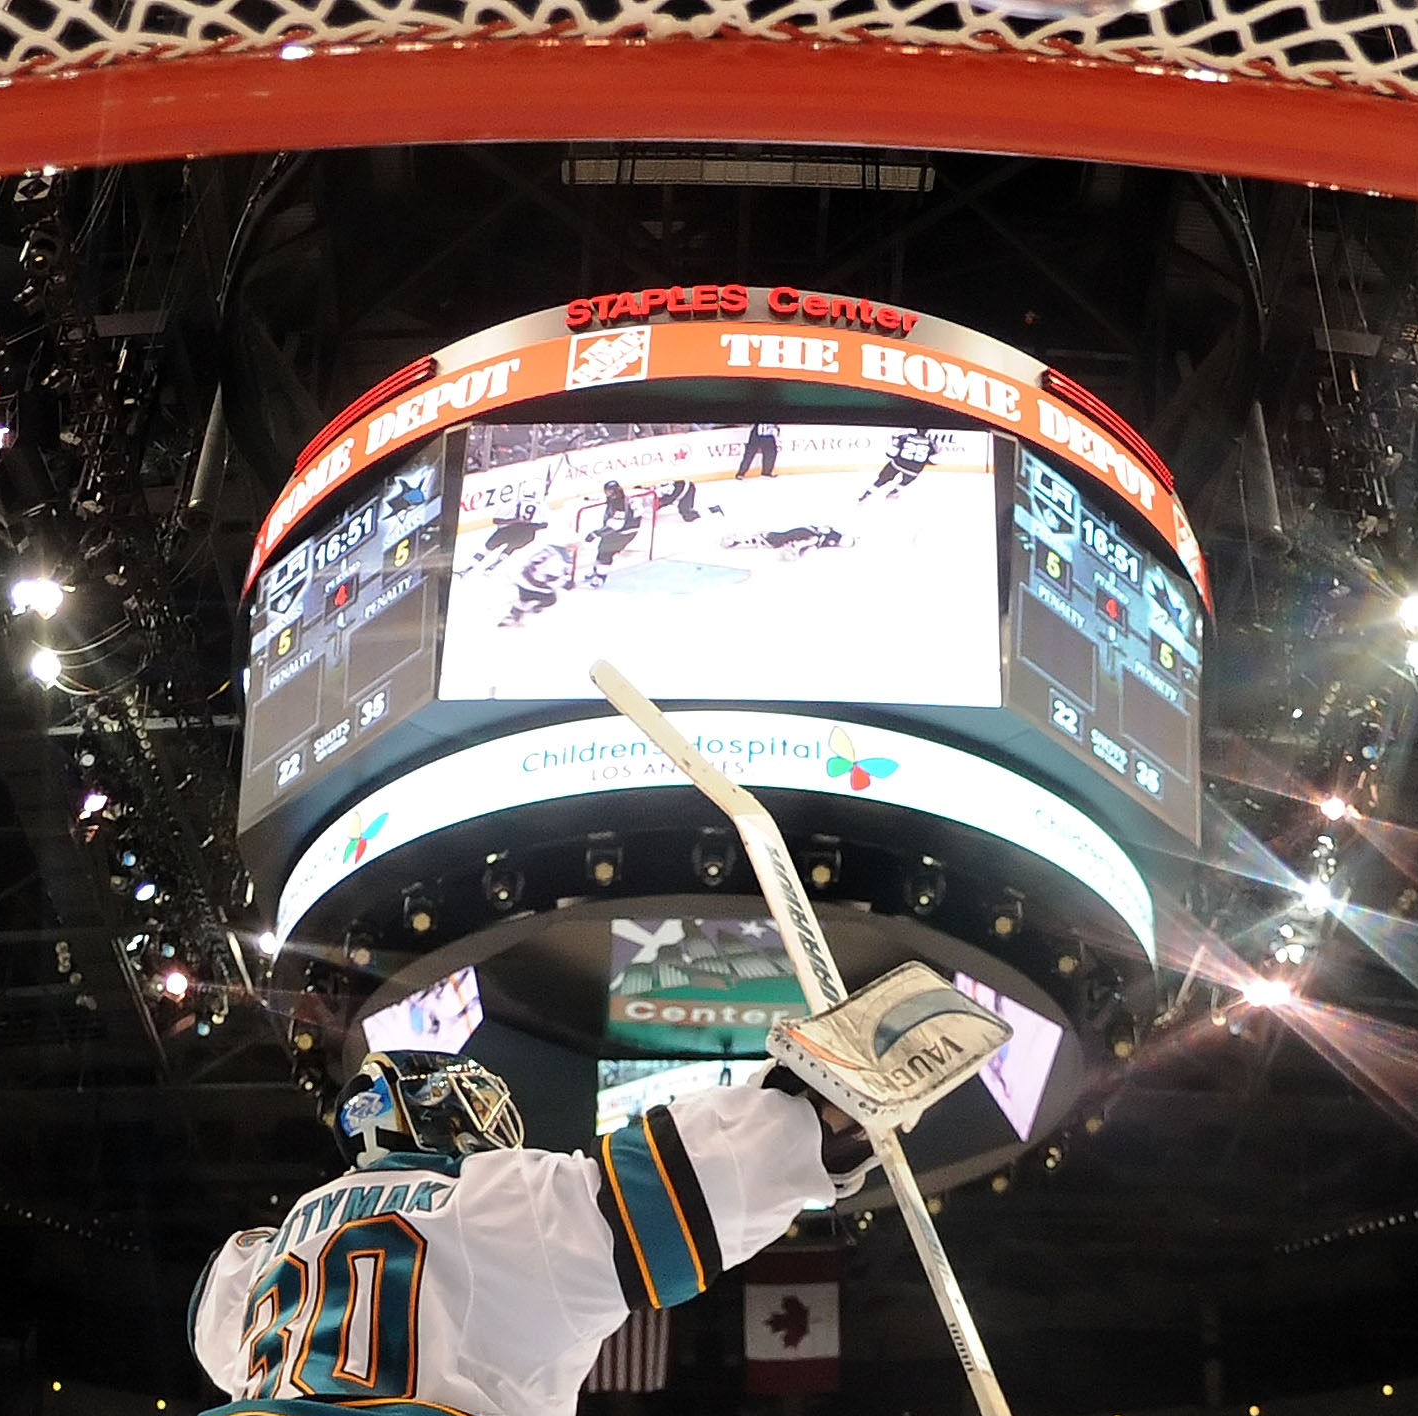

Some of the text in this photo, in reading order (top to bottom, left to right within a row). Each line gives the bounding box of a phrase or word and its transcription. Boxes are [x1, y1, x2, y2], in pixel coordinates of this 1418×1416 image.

[565, 284, 919, 332] STAPLES Center
[721, 333, 1156, 511] THE HOME DEPOT
[266, 357, 522, 549] HOME DEPOT
[708, 439, 783, 460] WES
[315, 509, 373, 570] 16:51
[394, 539, 410, 567] 5
[1082, 519, 1138, 582] 16:51
[1045, 552, 1061, 578] 5
[278, 629, 291, 655] 5
[1053, 699, 1078, 734] 22
[278, 753, 301, 786] 22
[592, 764, 632, 782] LOS
[624, 999, 790, 1028] Center
